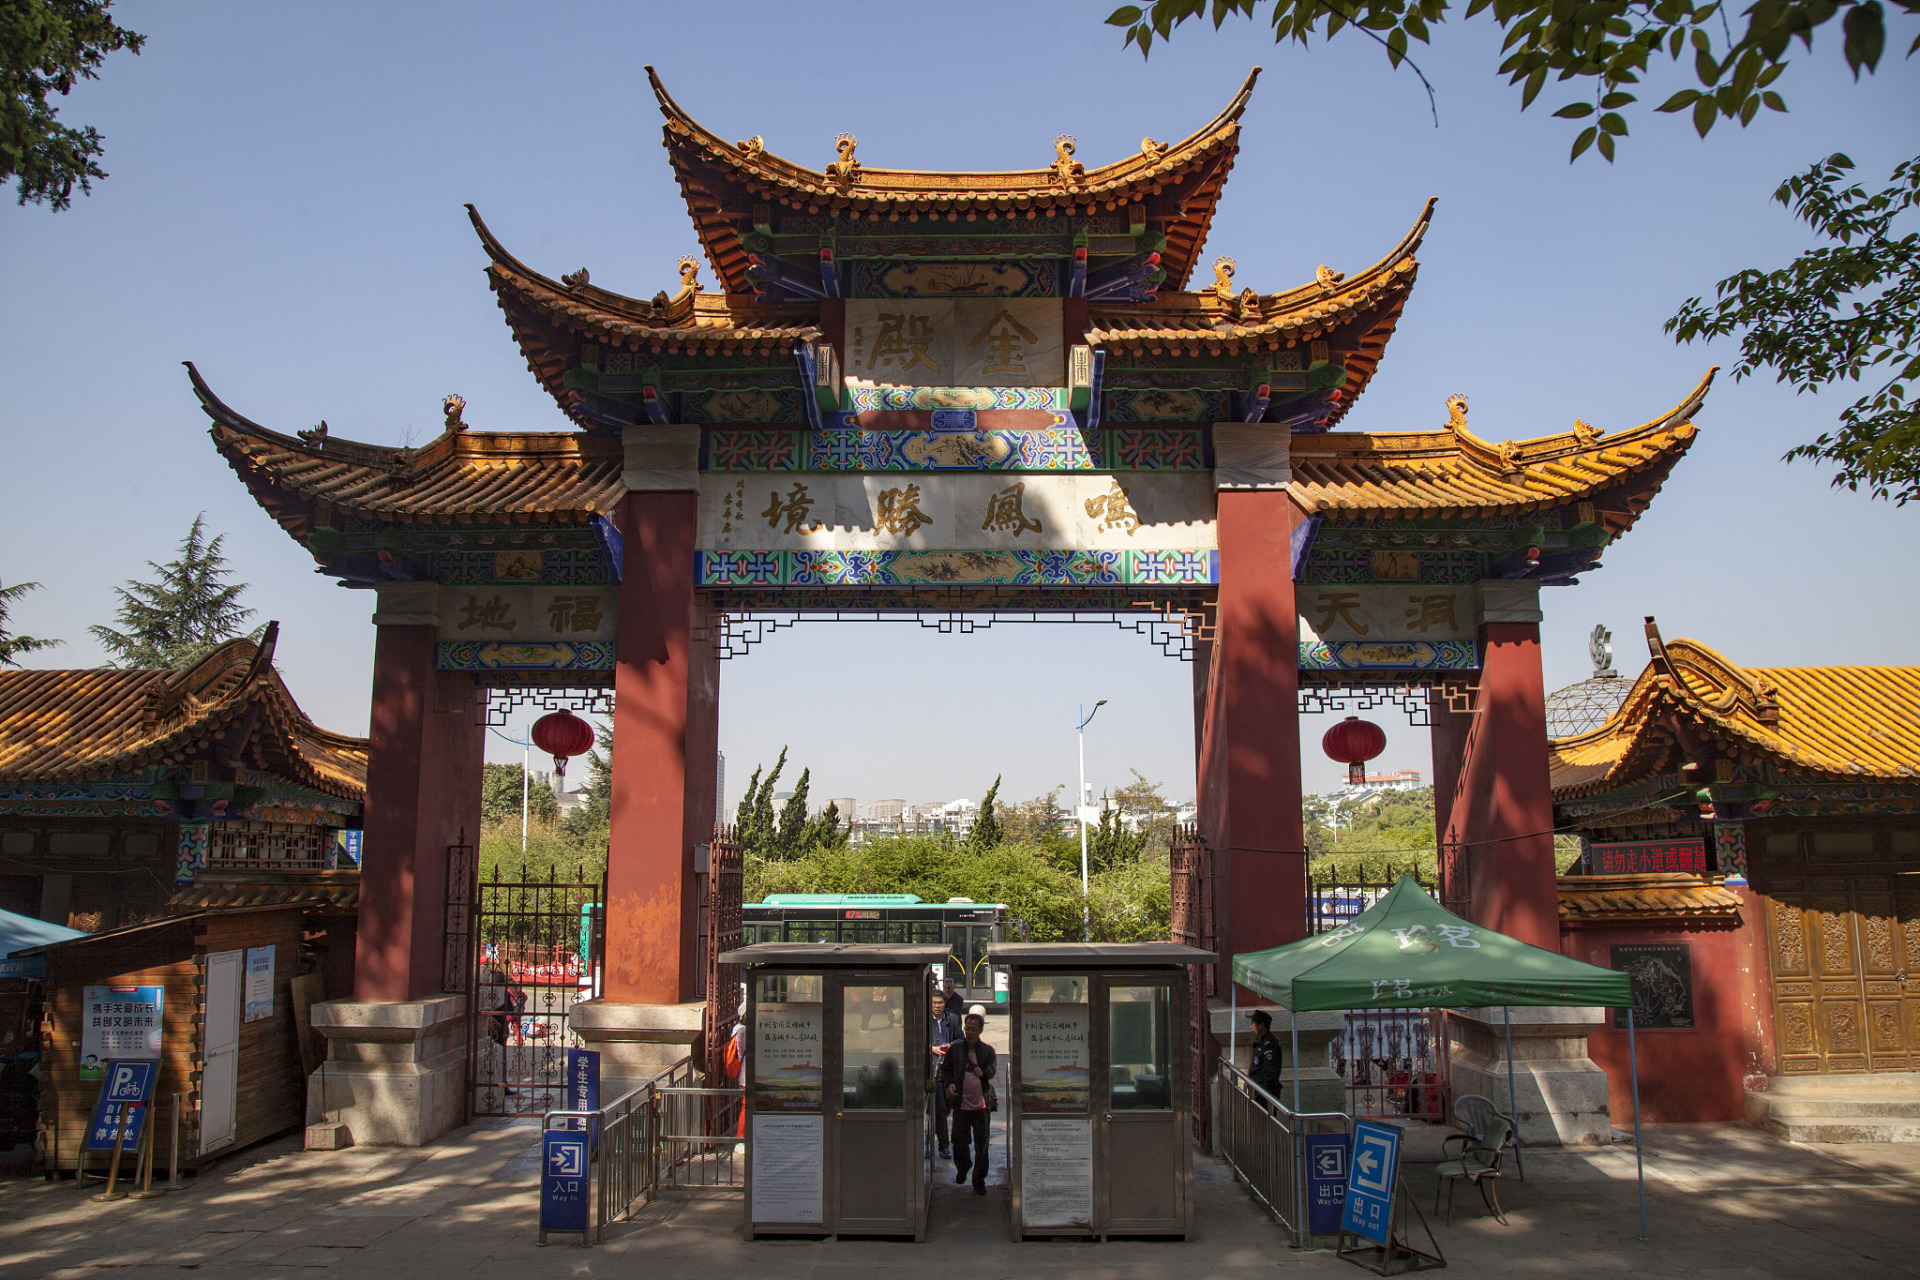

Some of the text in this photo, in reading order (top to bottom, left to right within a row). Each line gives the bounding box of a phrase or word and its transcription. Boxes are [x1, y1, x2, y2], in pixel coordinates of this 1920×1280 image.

[92, 1003, 155, 1014] 携手关爱成长
[92, 1016, 154, 1027] 共创文明未来
[111, 1067, 133, 1096] P
[553, 1181, 578, 1193] 入口
[1319, 1184, 1344, 1197] 出口
[552, 1194, 568, 1203] Way
[1317, 1198, 1332, 1206] Way
[1353, 1197, 1380, 1220] 出口
[1352, 1214, 1380, 1231] Way out
